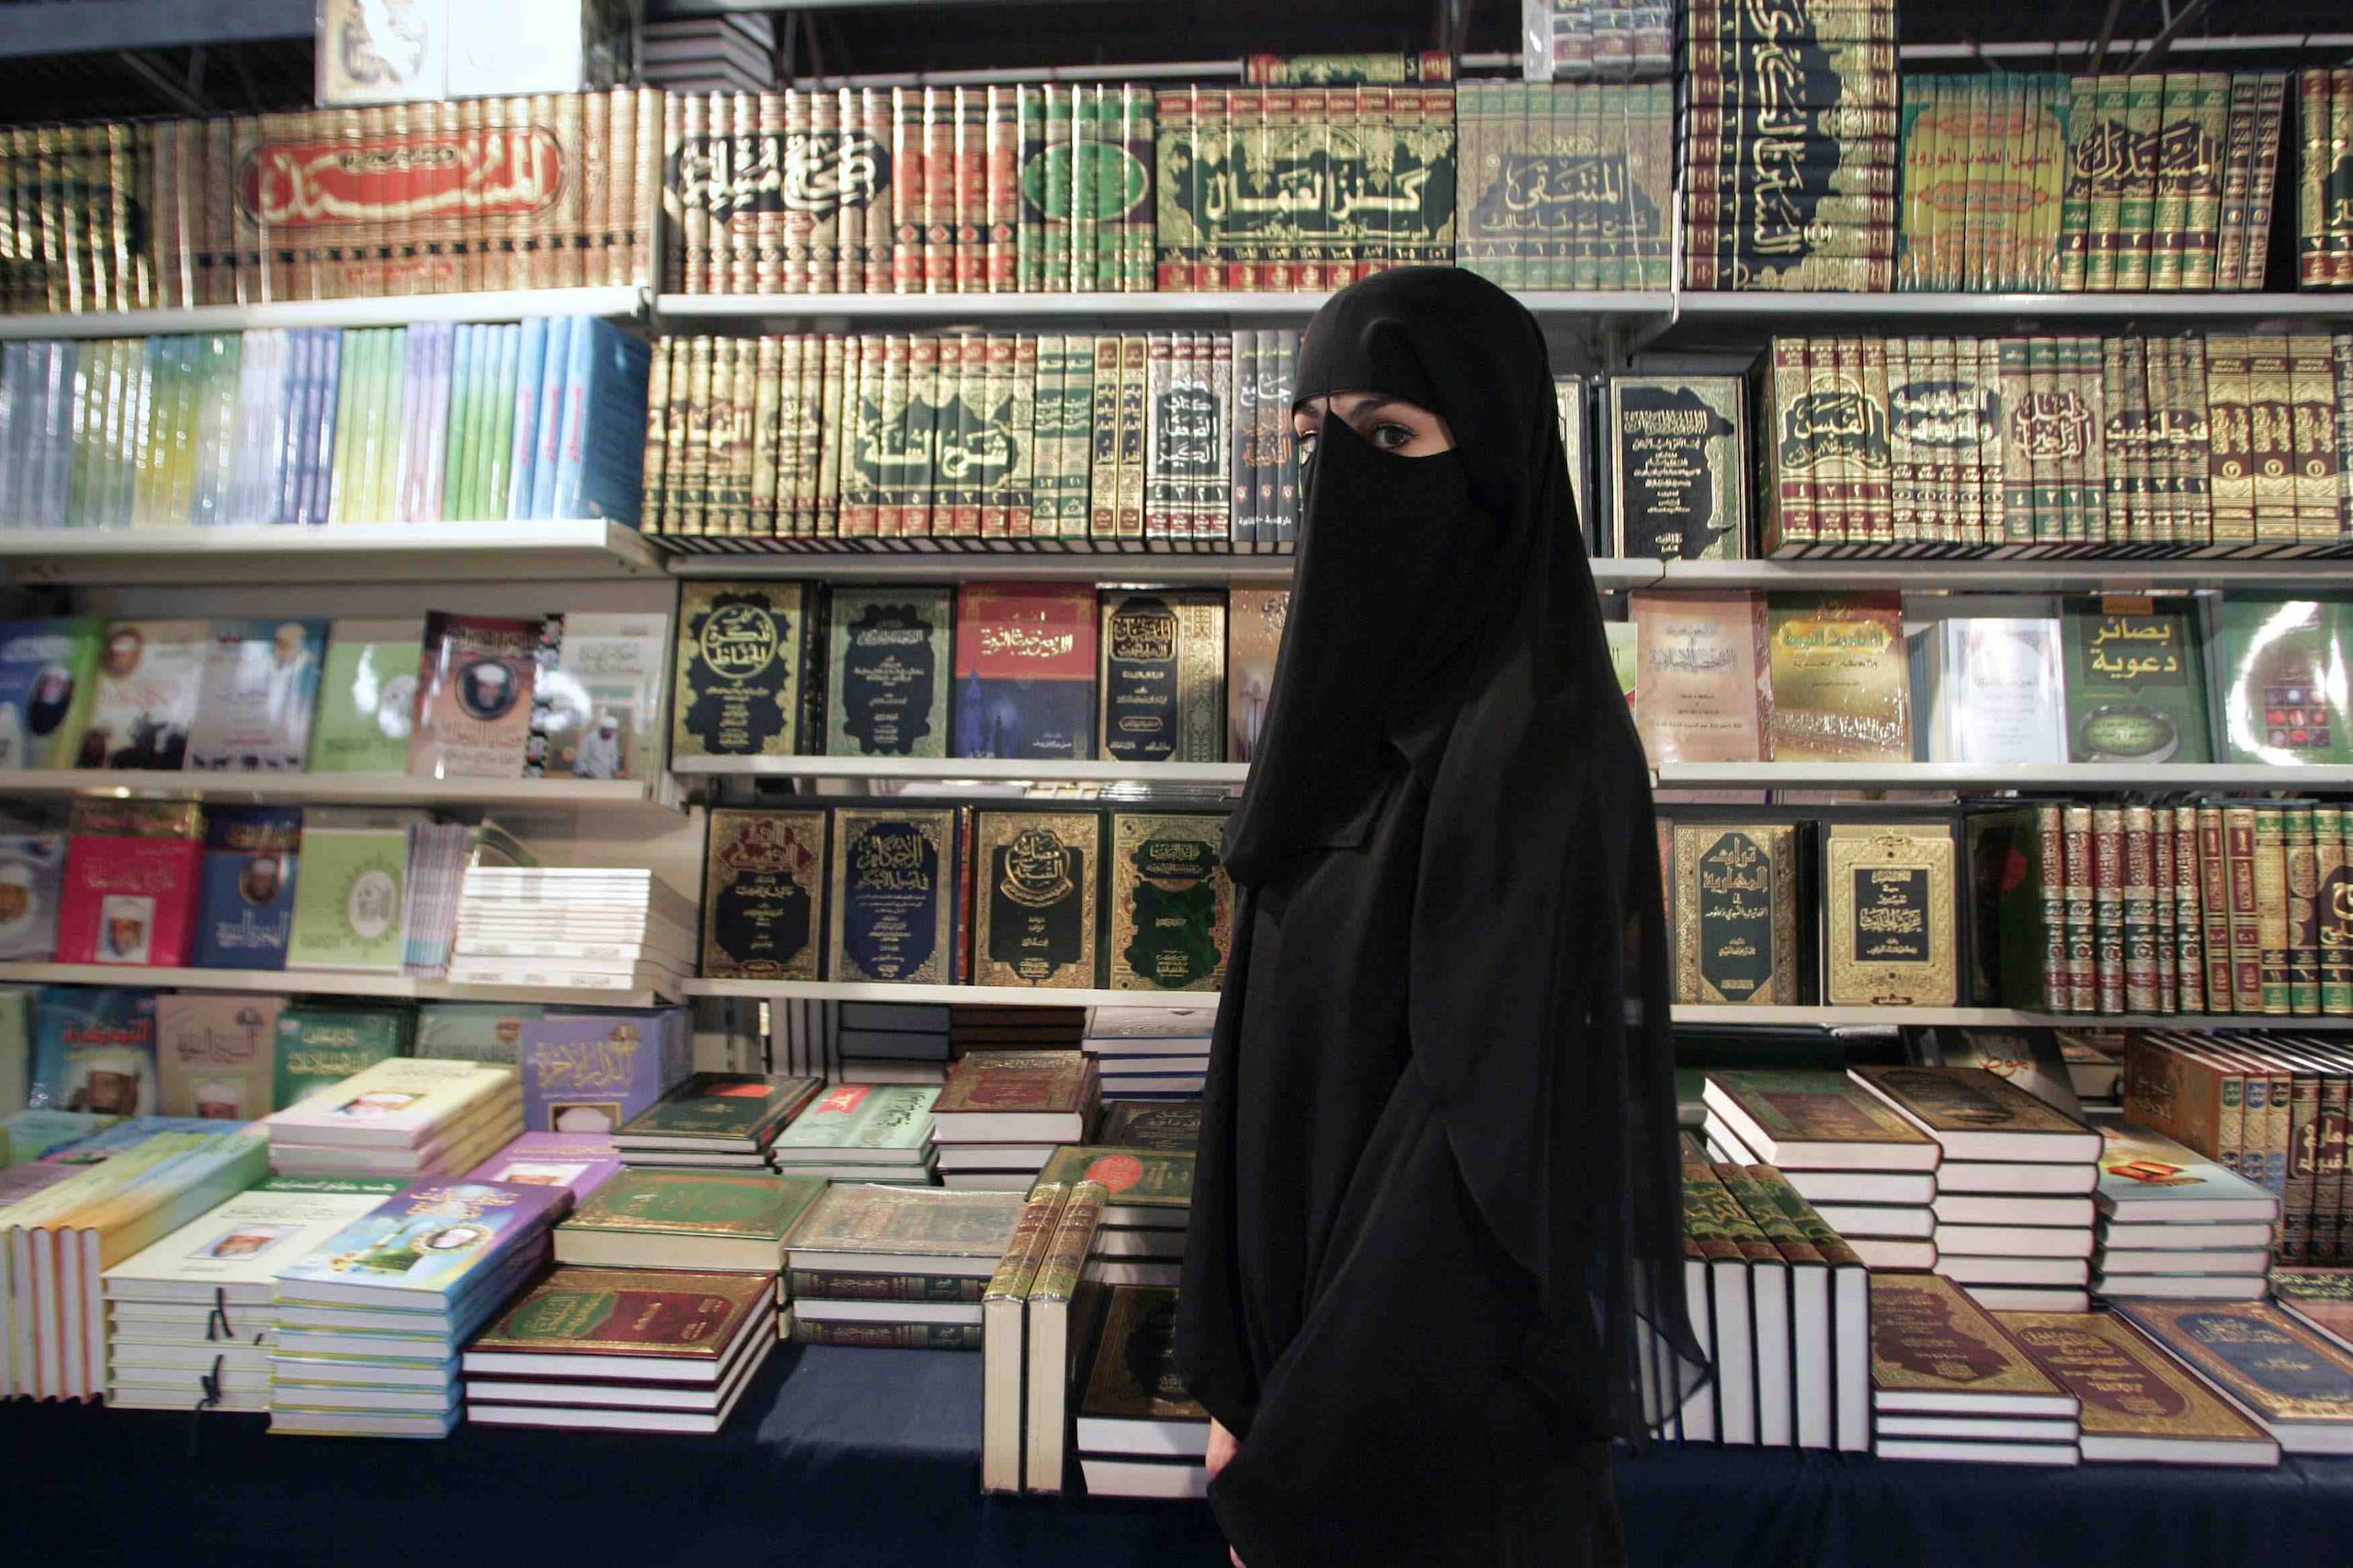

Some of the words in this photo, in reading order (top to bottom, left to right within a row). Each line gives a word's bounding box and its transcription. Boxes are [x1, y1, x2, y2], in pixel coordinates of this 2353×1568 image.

[2076, 119, 2219, 180] المستدرك
[1205, 166, 1334, 221] العمال
[1329, 163, 1431, 221] كنز
[1505, 160, 1625, 212] المنتقى
[1602, 209, 1648, 236] شرح
[1165, 395, 1212, 415] كتاب
[1239, 372, 1293, 407] جامع
[1893, 388, 1988, 415] الترغيب
[1160, 415, 1219, 438] الضعفاء
[1794, 399, 1874, 442] القبس
[941, 428, 1011, 479] شرح
[1157, 438, 1218, 469] الكبير
[2091, 616, 2173, 646] بصائر
[2089, 648, 2178, 679] دعوية
[1708, 836, 1757, 868] تراث
[1702, 865, 1769, 894] المغاربة
